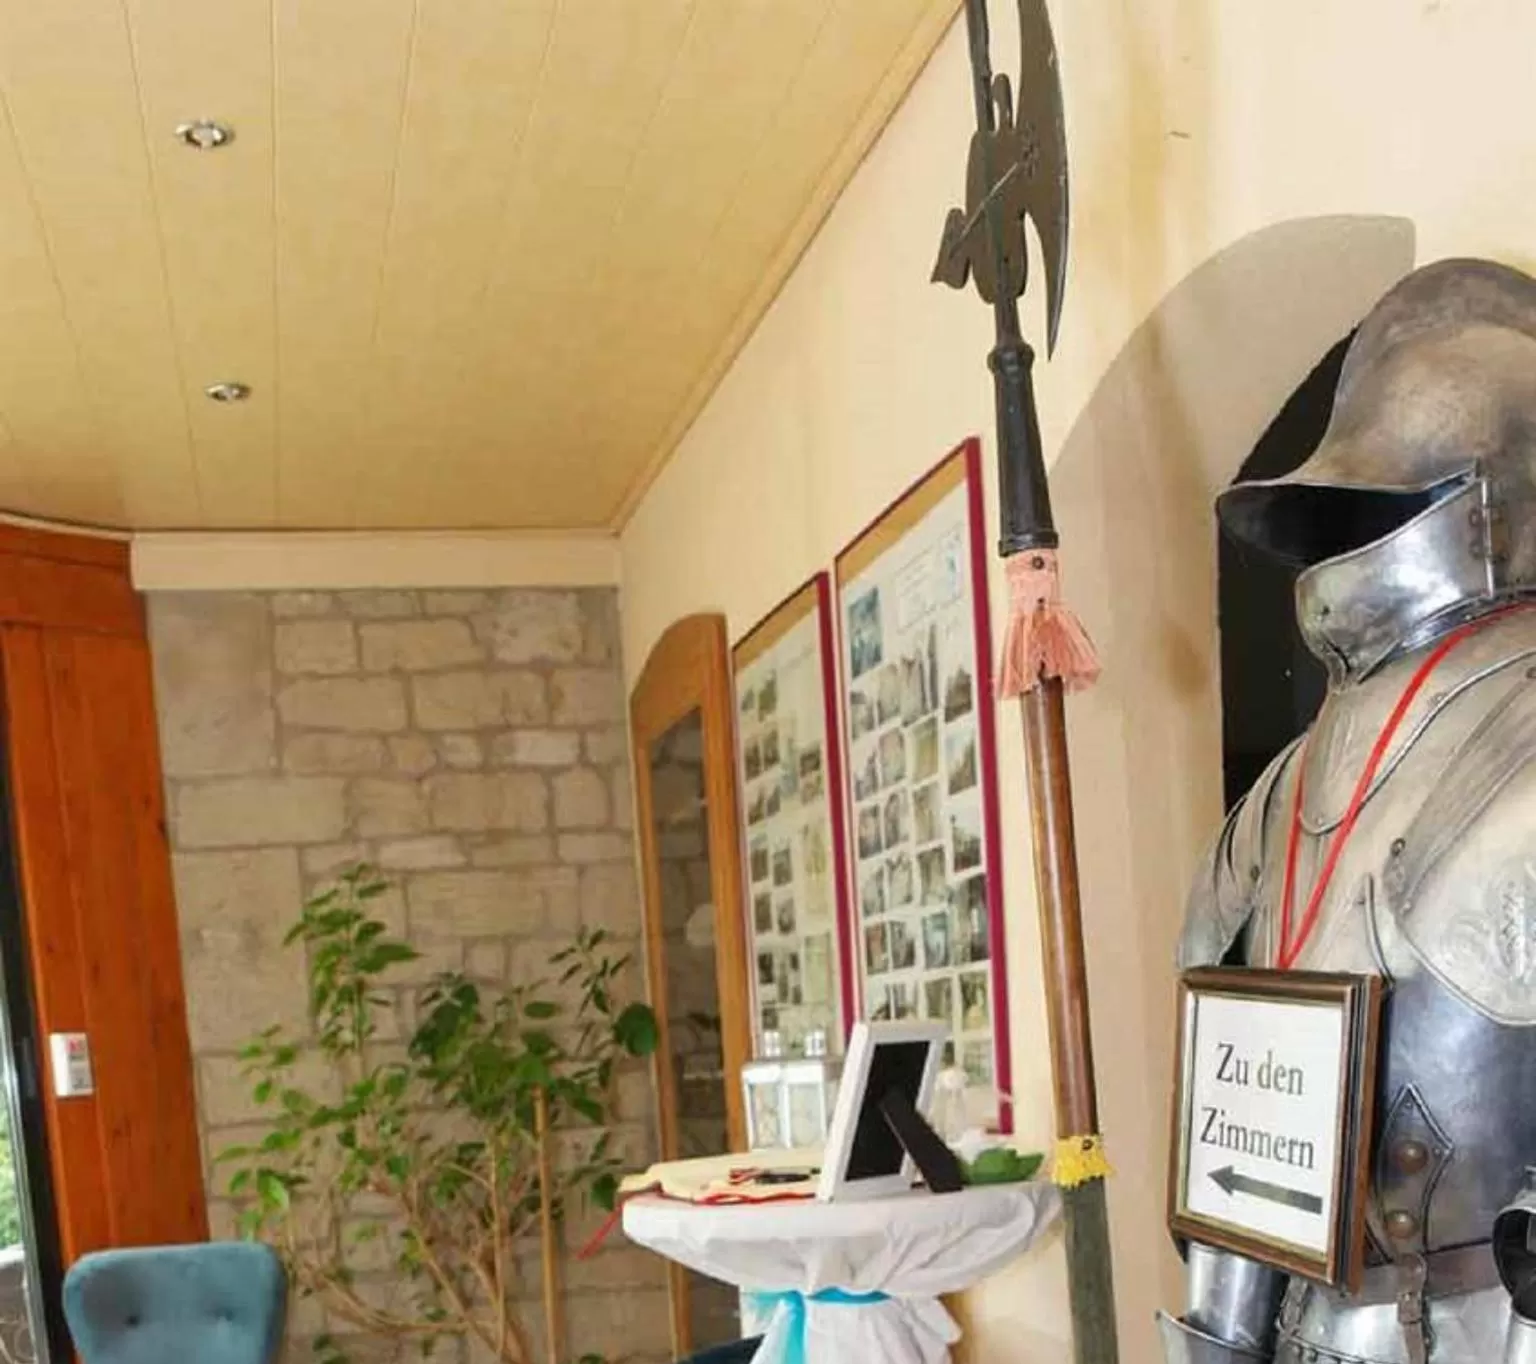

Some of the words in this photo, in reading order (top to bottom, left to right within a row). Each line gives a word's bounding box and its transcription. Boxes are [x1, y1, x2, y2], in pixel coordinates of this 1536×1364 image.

[1216, 1042, 1249, 1086] Zu
[1257, 1050, 1304, 1096] den
[1200, 1106, 1315, 1169] Zimmern
